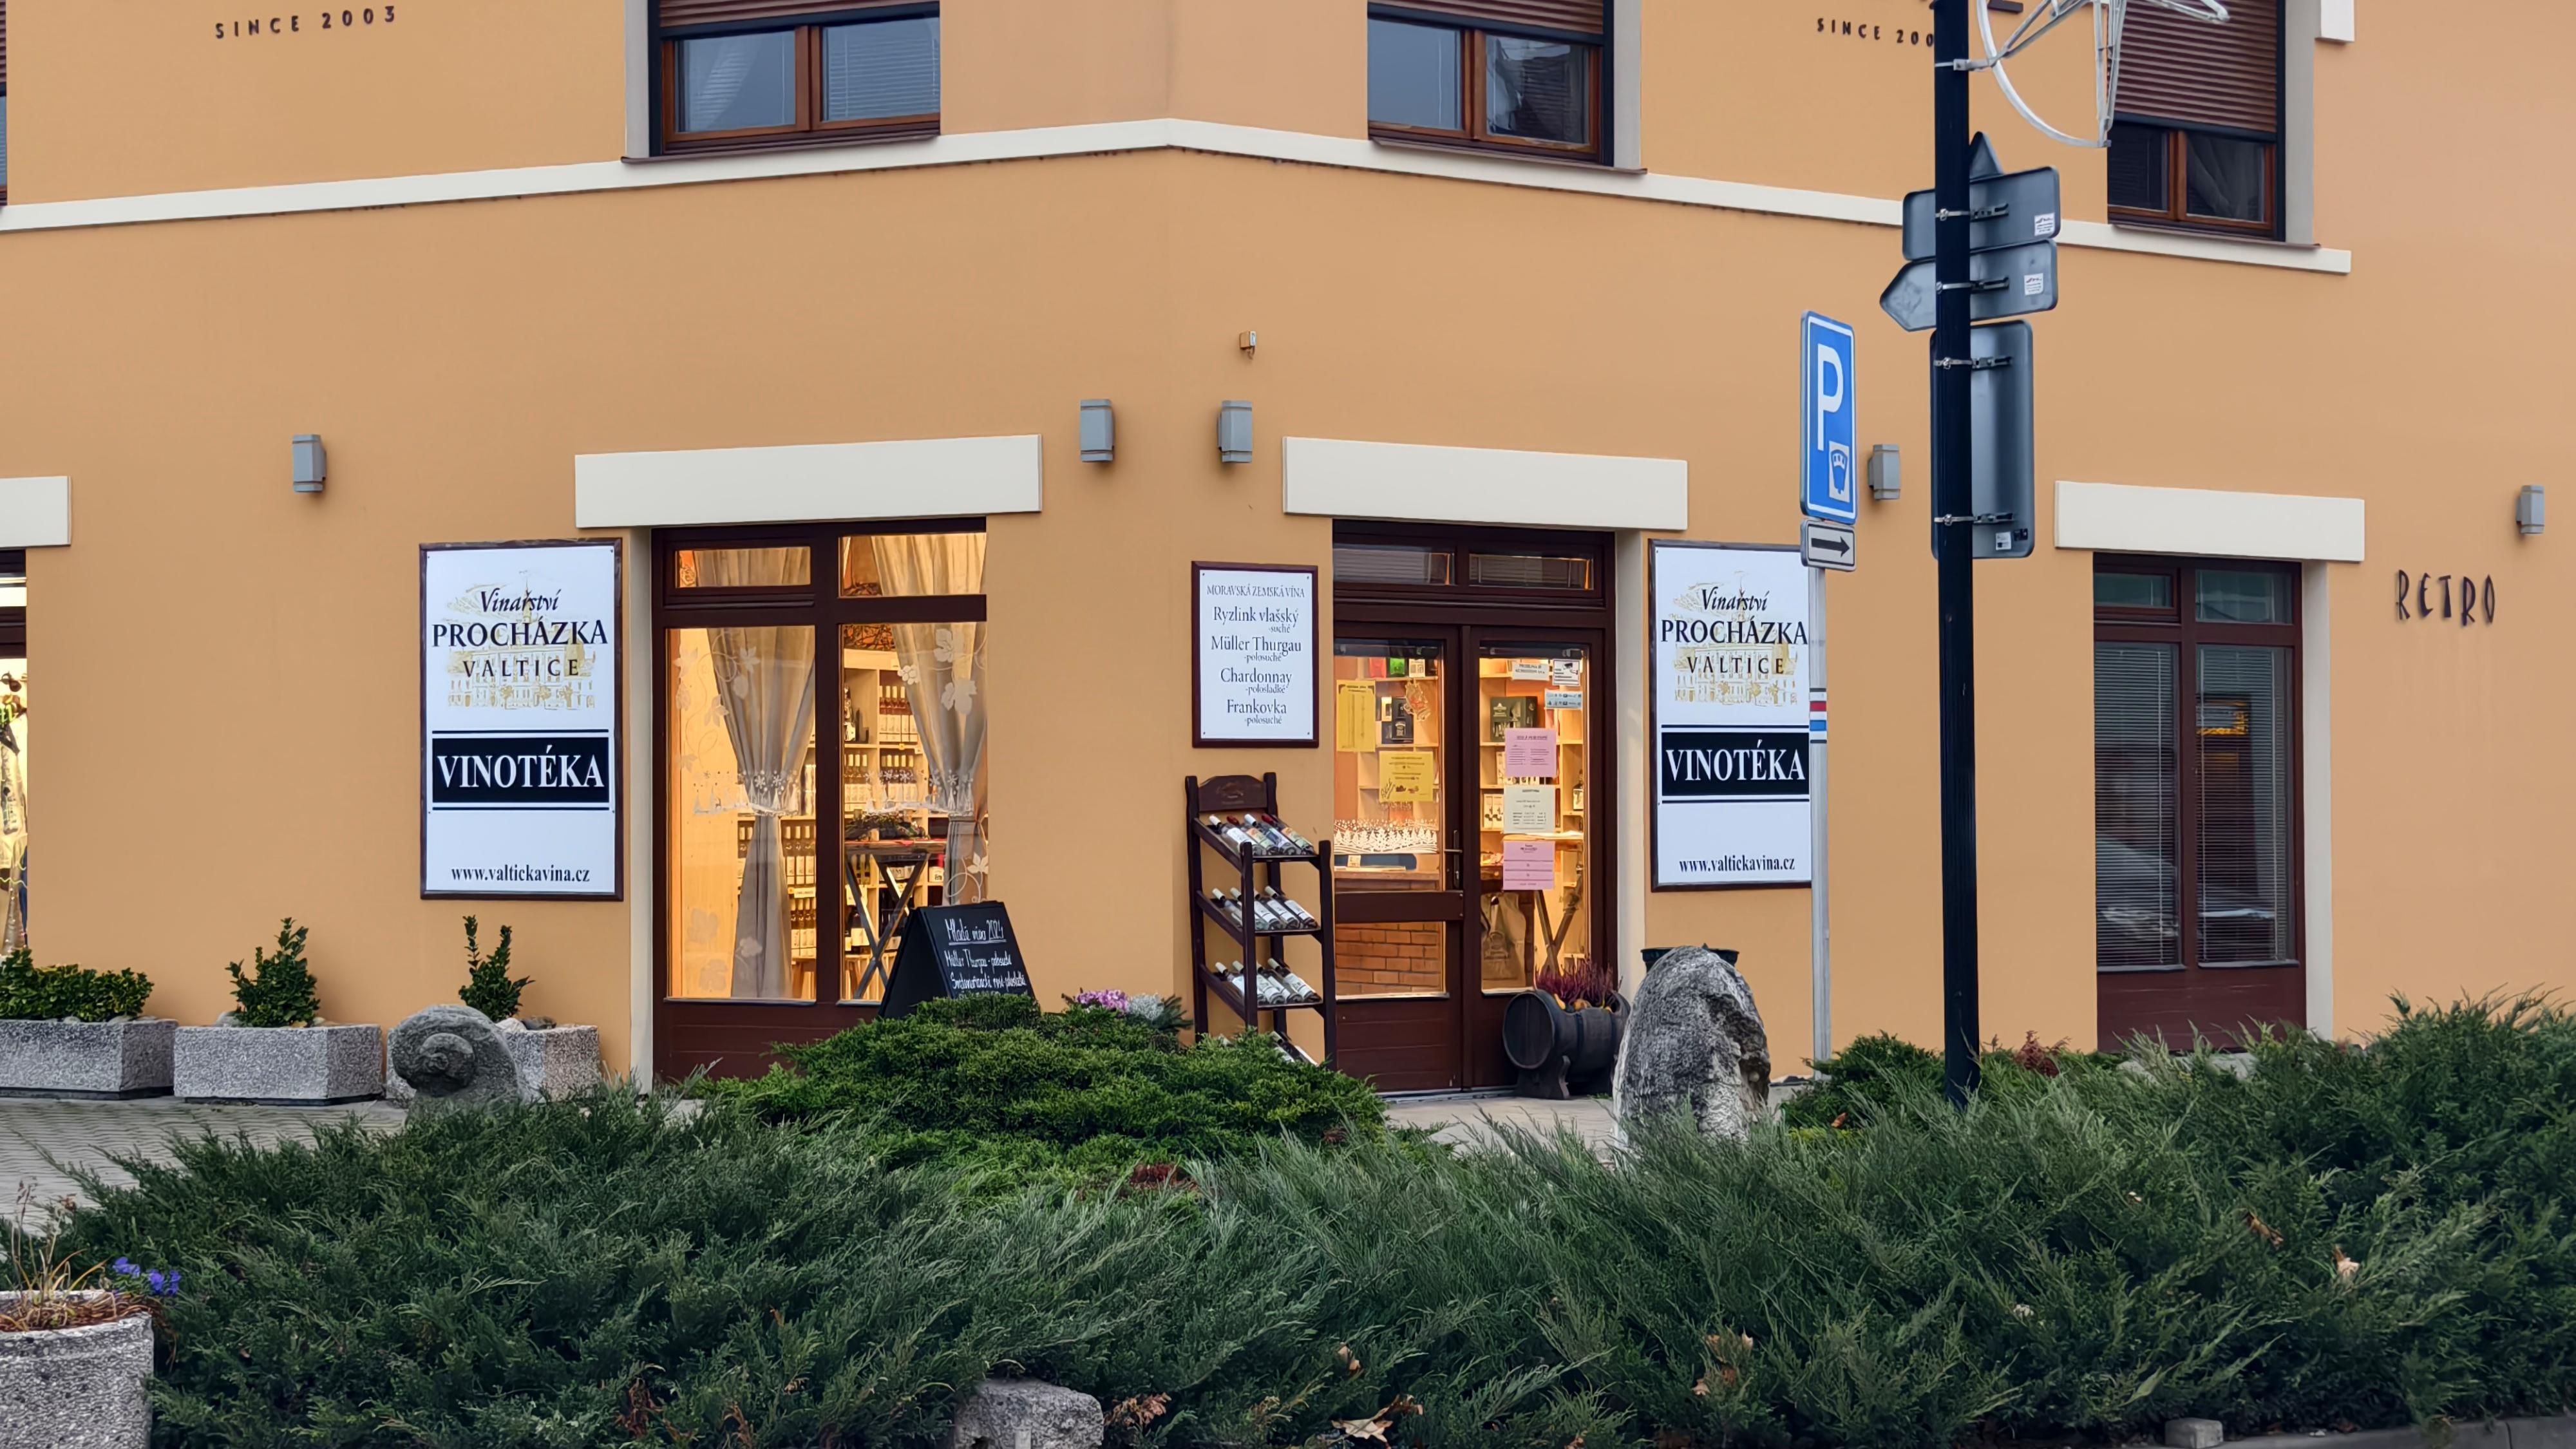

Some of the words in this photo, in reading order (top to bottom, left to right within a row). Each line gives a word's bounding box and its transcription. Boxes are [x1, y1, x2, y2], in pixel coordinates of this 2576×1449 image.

[215, 15, 299, 39] SINCE
[321, 6, 395, 29] 2003
[1817, 18, 1880, 40] SINCE
[1896, 29, 1935, 47] 200
[1817, 343, 1844, 451] P
[480, 587, 561, 613] Vinařství
[1207, 583, 1251, 596] MORAVSKÁ
[1252, 585, 1284, 597] ZEMSKÁ
[1285, 585, 1305, 598] VÍNA
[1700, 587, 1770, 611] Vinařství
[2396, 569, 2496, 627] RETRO
[1213, 606, 1256, 625] Ryzlink
[1259, 607, 1299, 627] vlašský
[432, 616, 609, 647] PROCHÁZKA
[1661, 616, 1808, 645] PROCHÁZKA
[1211, 635, 1250, 650] Müller
[1252, 636, 1302, 657] Thurgau
[462, 659, 579, 677] VALTICE
[1220, 667, 1293, 688] Chardonnay
[1687, 656, 1785, 675] VALTICE
[1227, 698, 1287, 714] Frankovka
[437, 744, 605, 788] VINOTÉKA
[1665, 739, 1806, 782] VINOTÉKA
[451, 864, 591, 882] www.valtickavina.cz
[1679, 855, 1795, 873] www.valtickavina.cz
